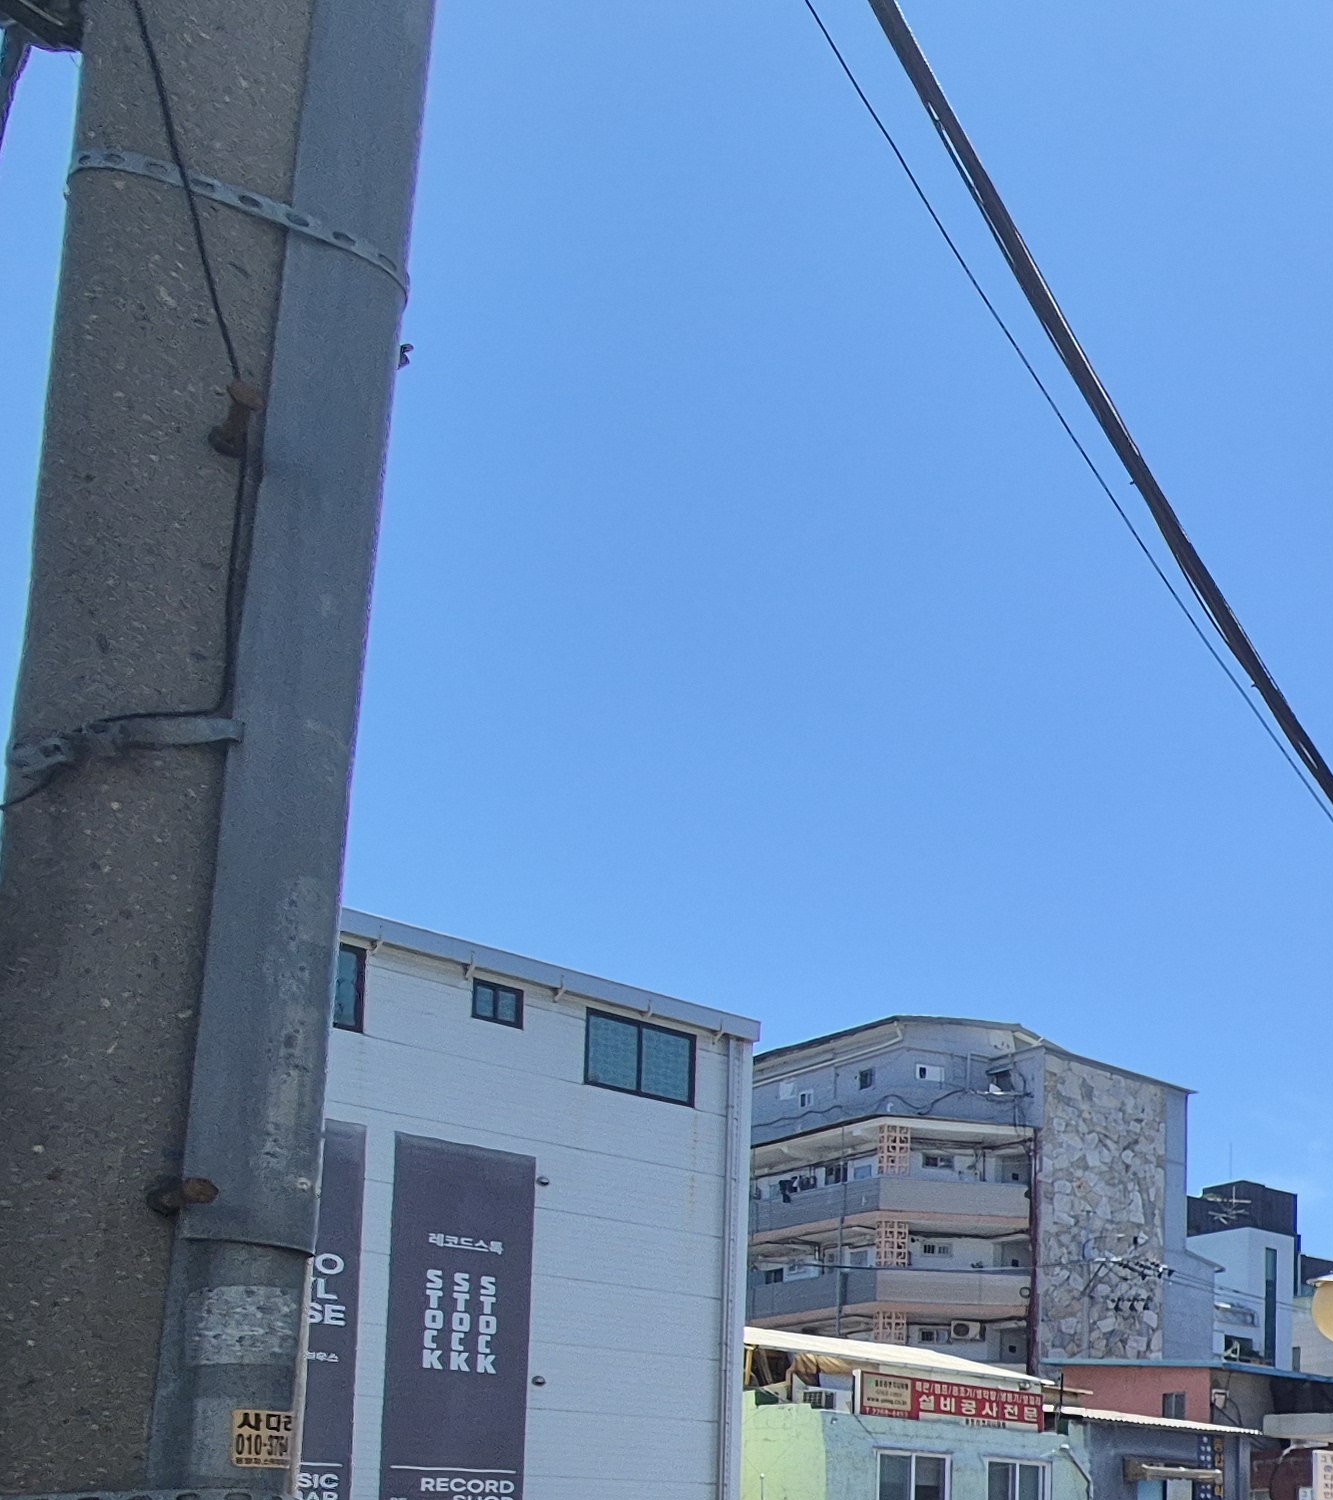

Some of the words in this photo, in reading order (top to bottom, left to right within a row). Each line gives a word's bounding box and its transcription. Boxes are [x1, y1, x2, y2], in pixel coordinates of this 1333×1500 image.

[307, 1302, 347, 1326] SE
[297, 1472, 340, 1489] SIC
[420, 1477, 515, 1494] RECORD
